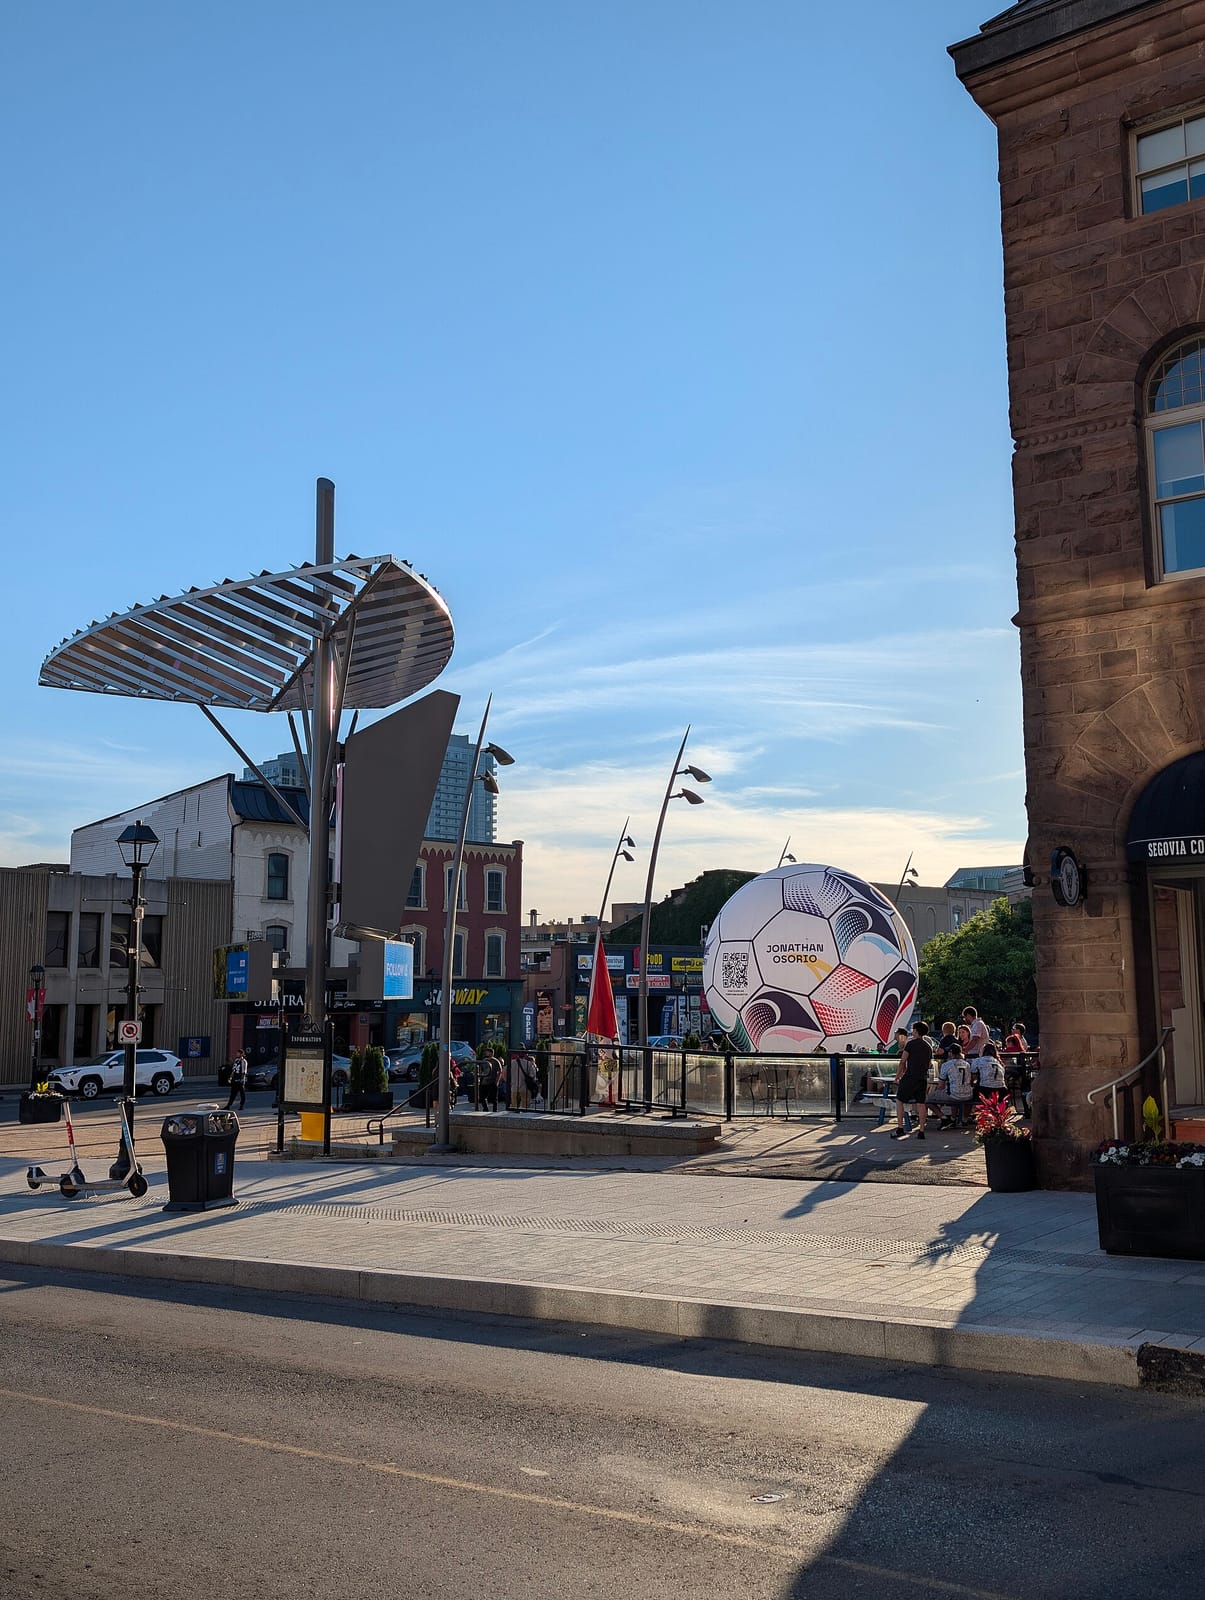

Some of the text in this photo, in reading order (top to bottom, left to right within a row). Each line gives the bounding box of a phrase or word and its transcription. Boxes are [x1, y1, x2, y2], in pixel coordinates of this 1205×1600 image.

[1148, 840, 1187, 857] SEGOVIA
[766, 943, 824, 953] JONATHAN
[772, 954, 818, 964] OSORIO
[959, 1067, 966, 1085] 7
[991, 1063, 999, 1079] 7
